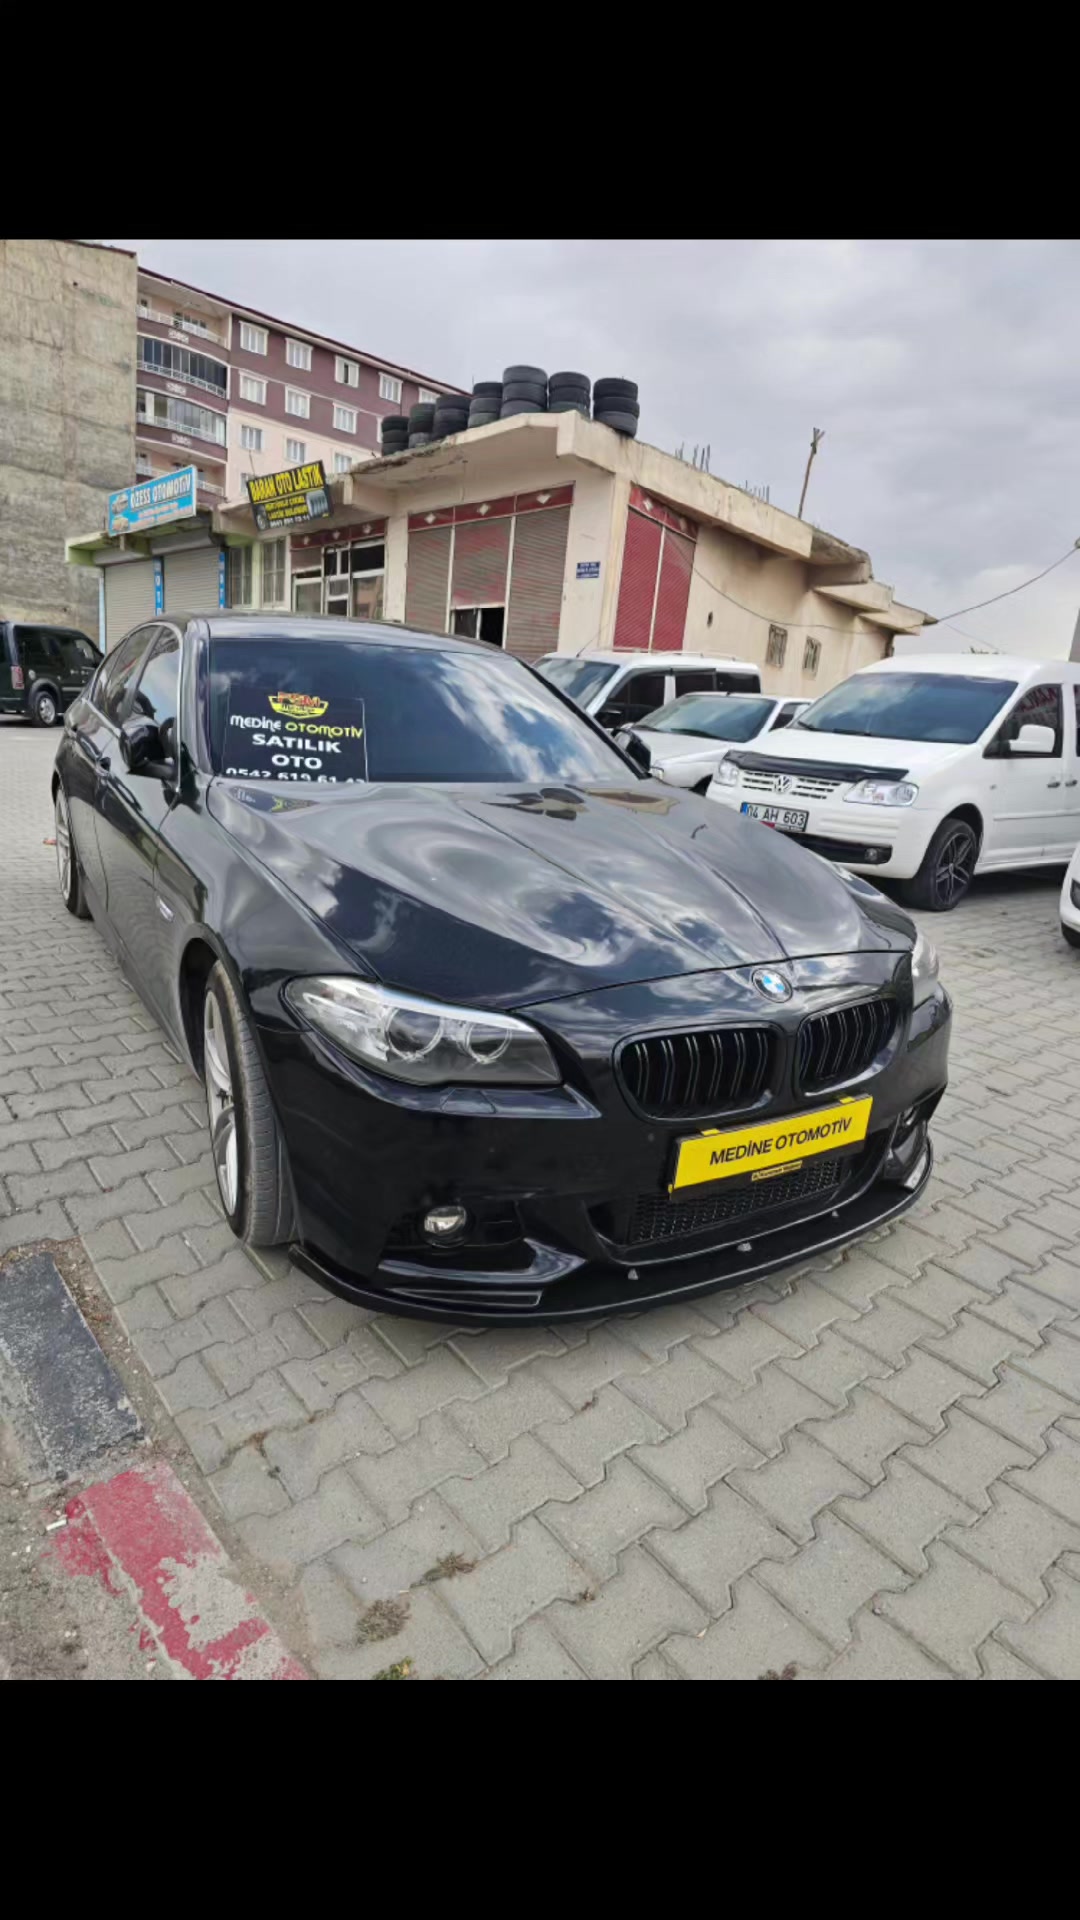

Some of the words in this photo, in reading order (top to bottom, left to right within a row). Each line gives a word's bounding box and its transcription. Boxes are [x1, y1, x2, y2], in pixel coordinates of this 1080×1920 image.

[275, 471, 293, 495] OTO
[252, 734, 341, 753] SATILIK
[271, 754, 323, 770] OTO
[762, 808, 779, 821] AH
[783, 812, 805, 826] 603
[709, 1138, 773, 1165] MEDİNE
[775, 1117, 852, 1149] OTOMOTİV
